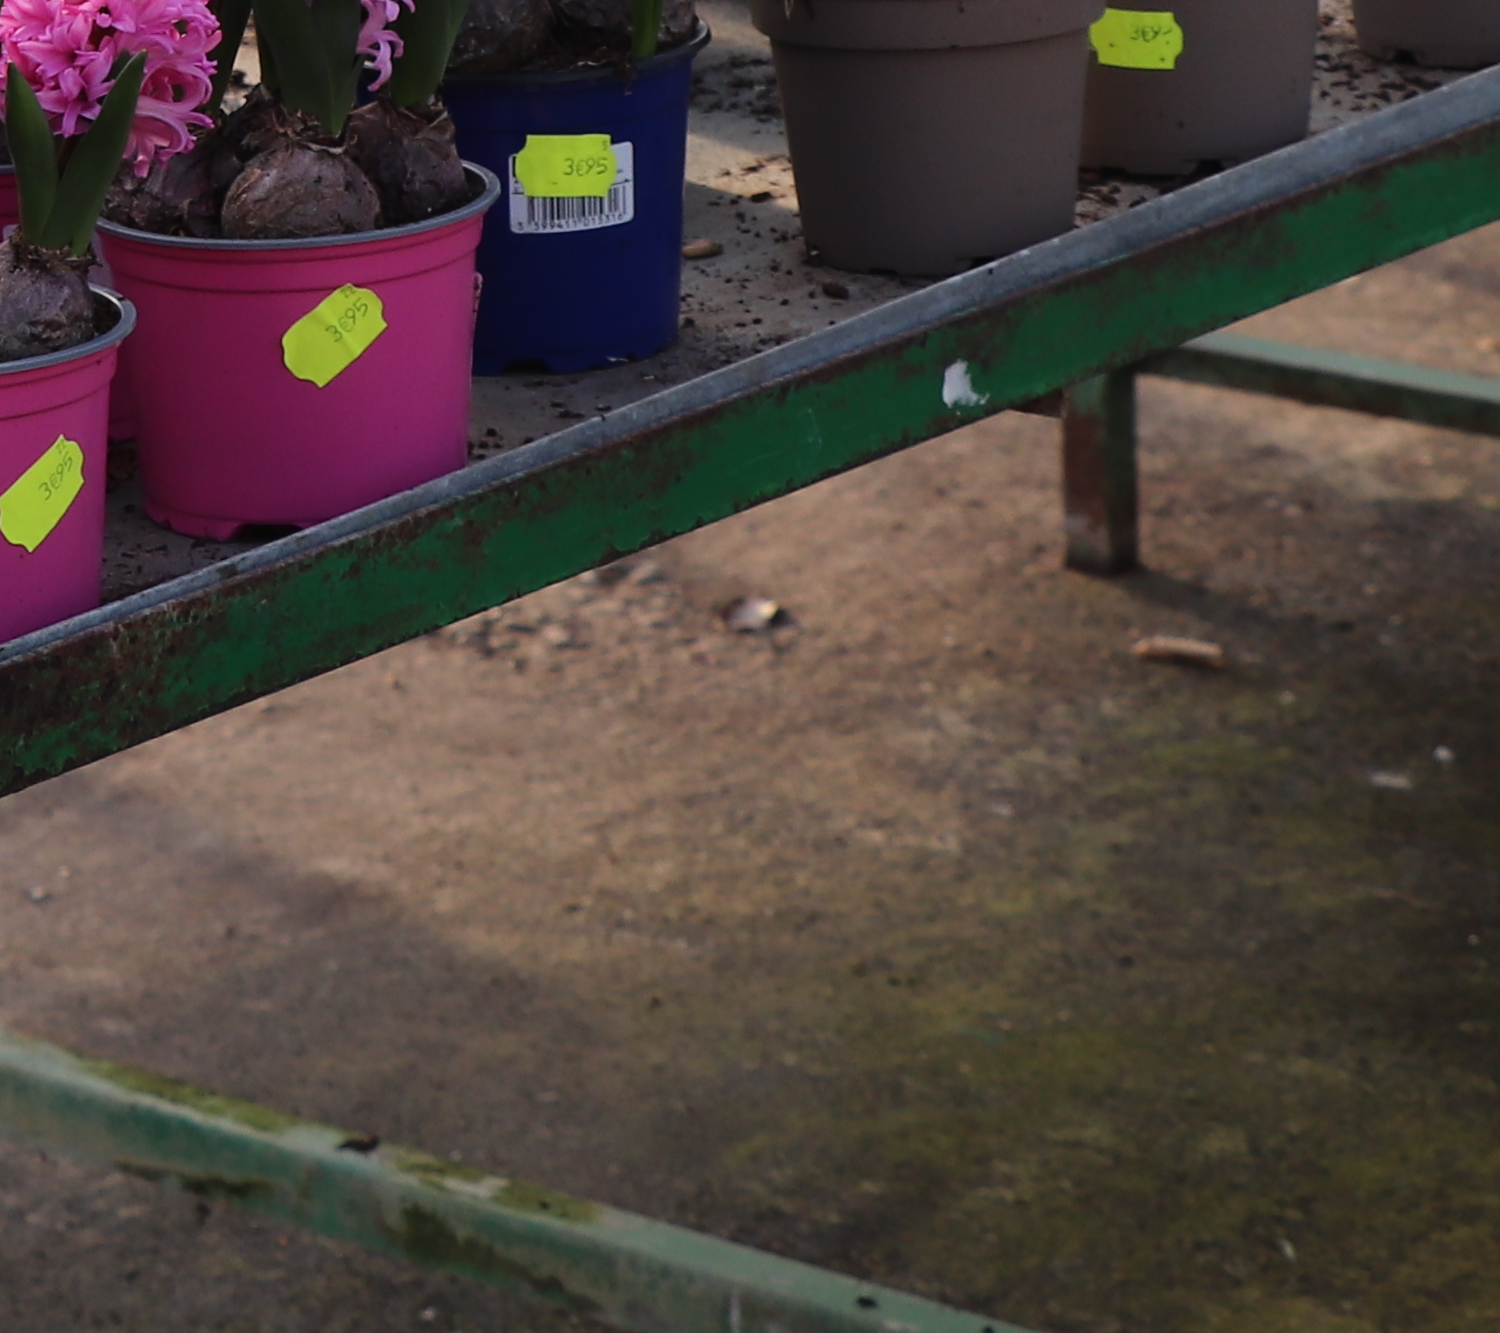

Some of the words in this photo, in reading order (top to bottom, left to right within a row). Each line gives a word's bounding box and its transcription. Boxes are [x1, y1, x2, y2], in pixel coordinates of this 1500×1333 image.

[563, 156, 609, 177] 3€95
[325, 297, 370, 343] 3€95
[38, 450, 74, 502] 3€95
